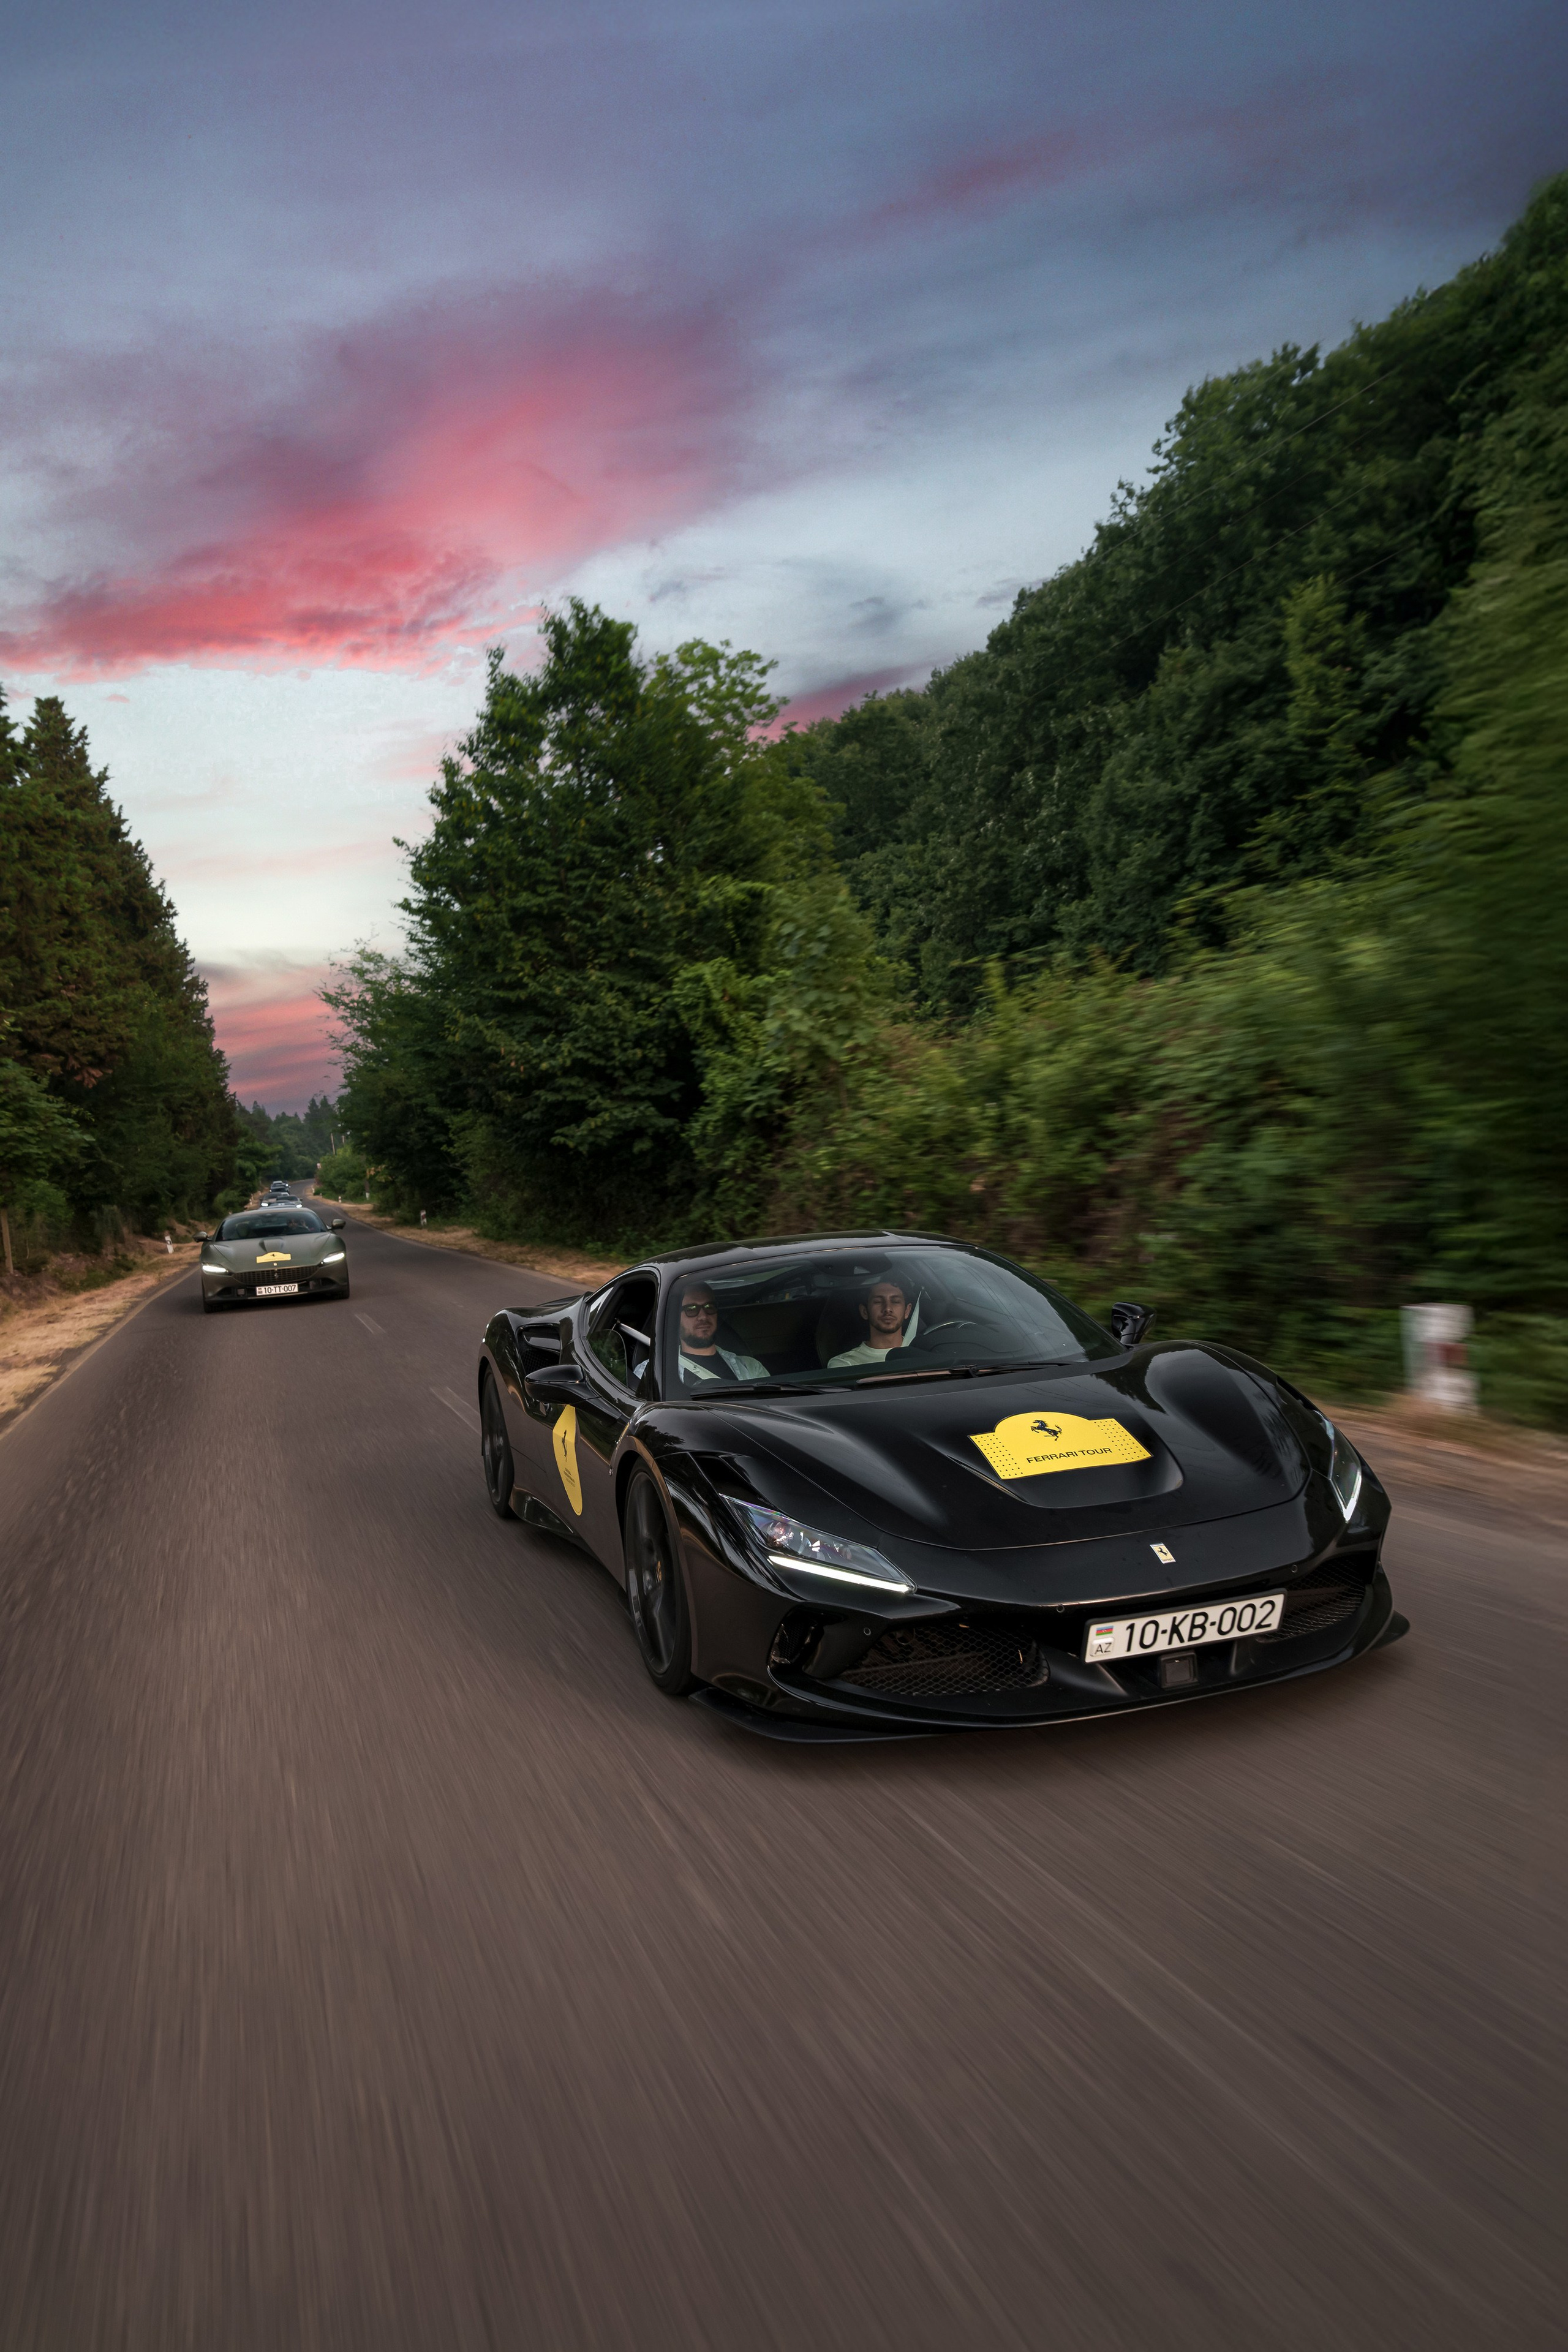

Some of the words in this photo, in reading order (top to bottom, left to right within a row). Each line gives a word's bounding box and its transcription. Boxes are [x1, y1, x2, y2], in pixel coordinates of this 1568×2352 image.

[264, 1284, 296, 1294] 10-TT-007
[1026, 1451, 1079, 1463] FERRARI
[1078, 1447, 1113, 1456] TOUR
[1126, 1599, 1276, 1653] 10-KB-002
[1095, 1642, 1112, 1655] AZ
